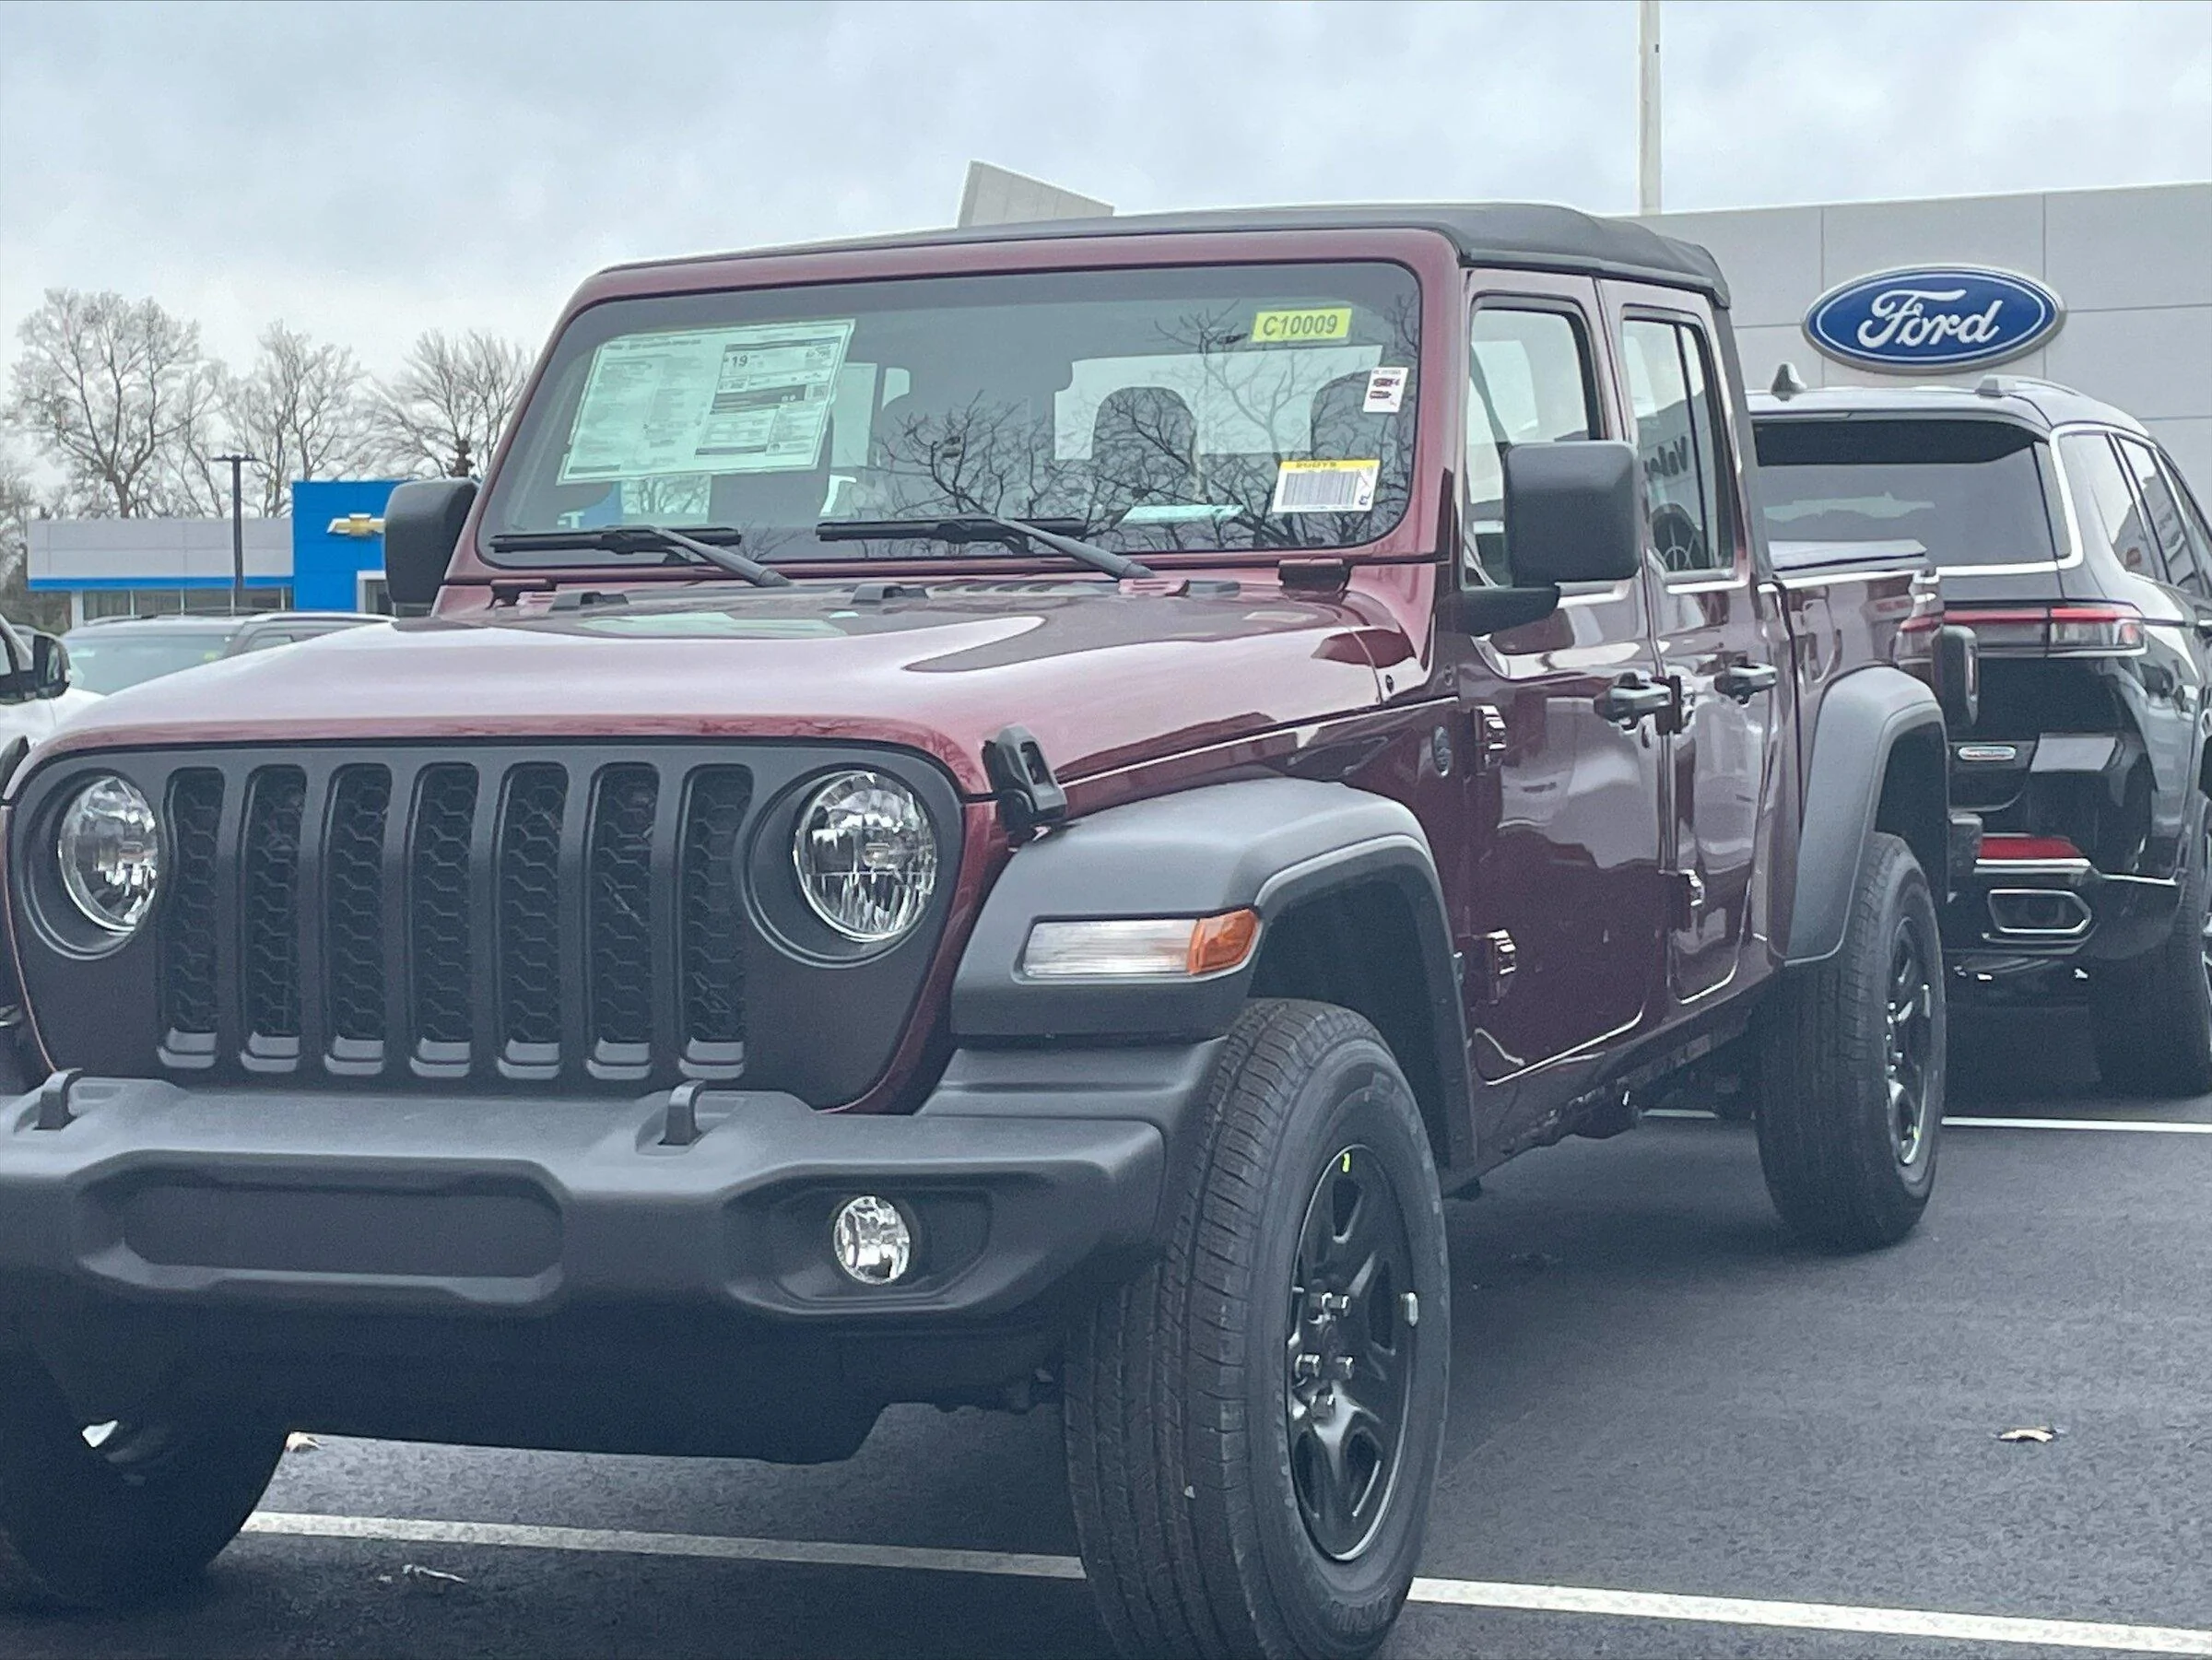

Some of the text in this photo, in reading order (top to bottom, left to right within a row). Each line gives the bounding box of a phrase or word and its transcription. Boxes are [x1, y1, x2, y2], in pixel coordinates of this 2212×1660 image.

[1263, 313, 1338, 336] C10009
[1857, 288, 2004, 348] Ford
[731, 354, 748, 368] 19
